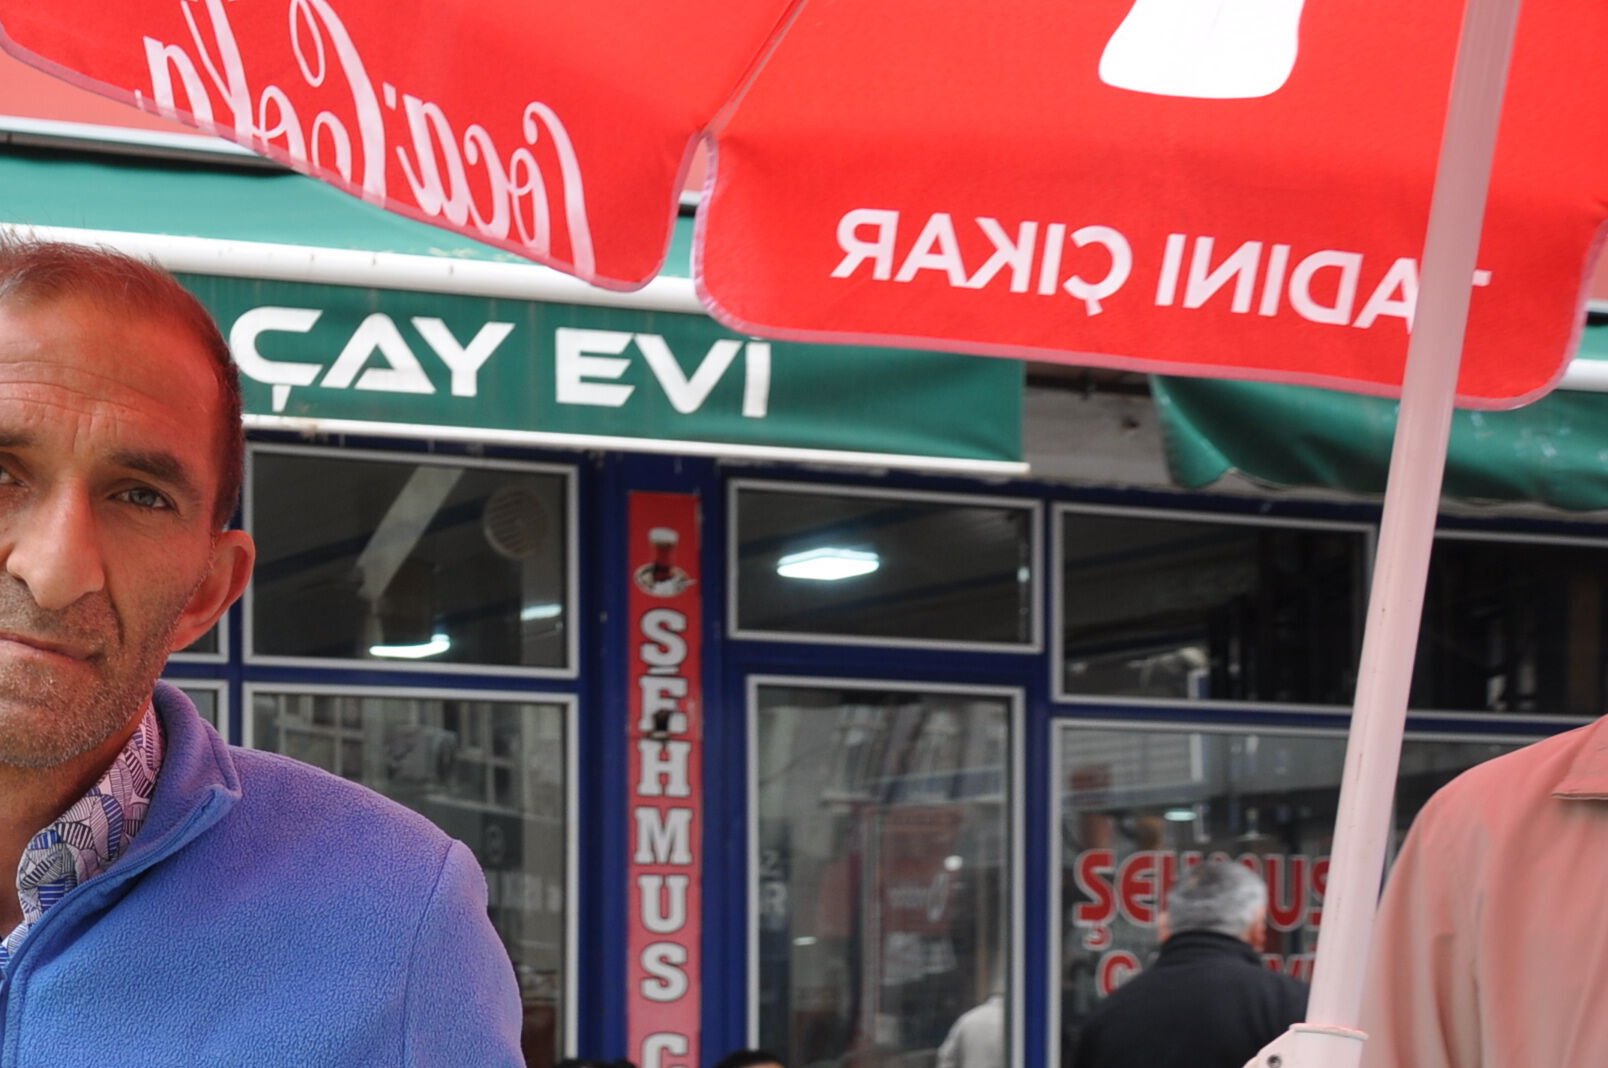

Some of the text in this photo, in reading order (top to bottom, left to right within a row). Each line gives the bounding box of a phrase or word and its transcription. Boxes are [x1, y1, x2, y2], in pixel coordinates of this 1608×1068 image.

[229, 305, 515, 412] ÇAY
[555, 326, 772, 419] EVİ
[634, 607, 693, 1002] ŞEHMUS
